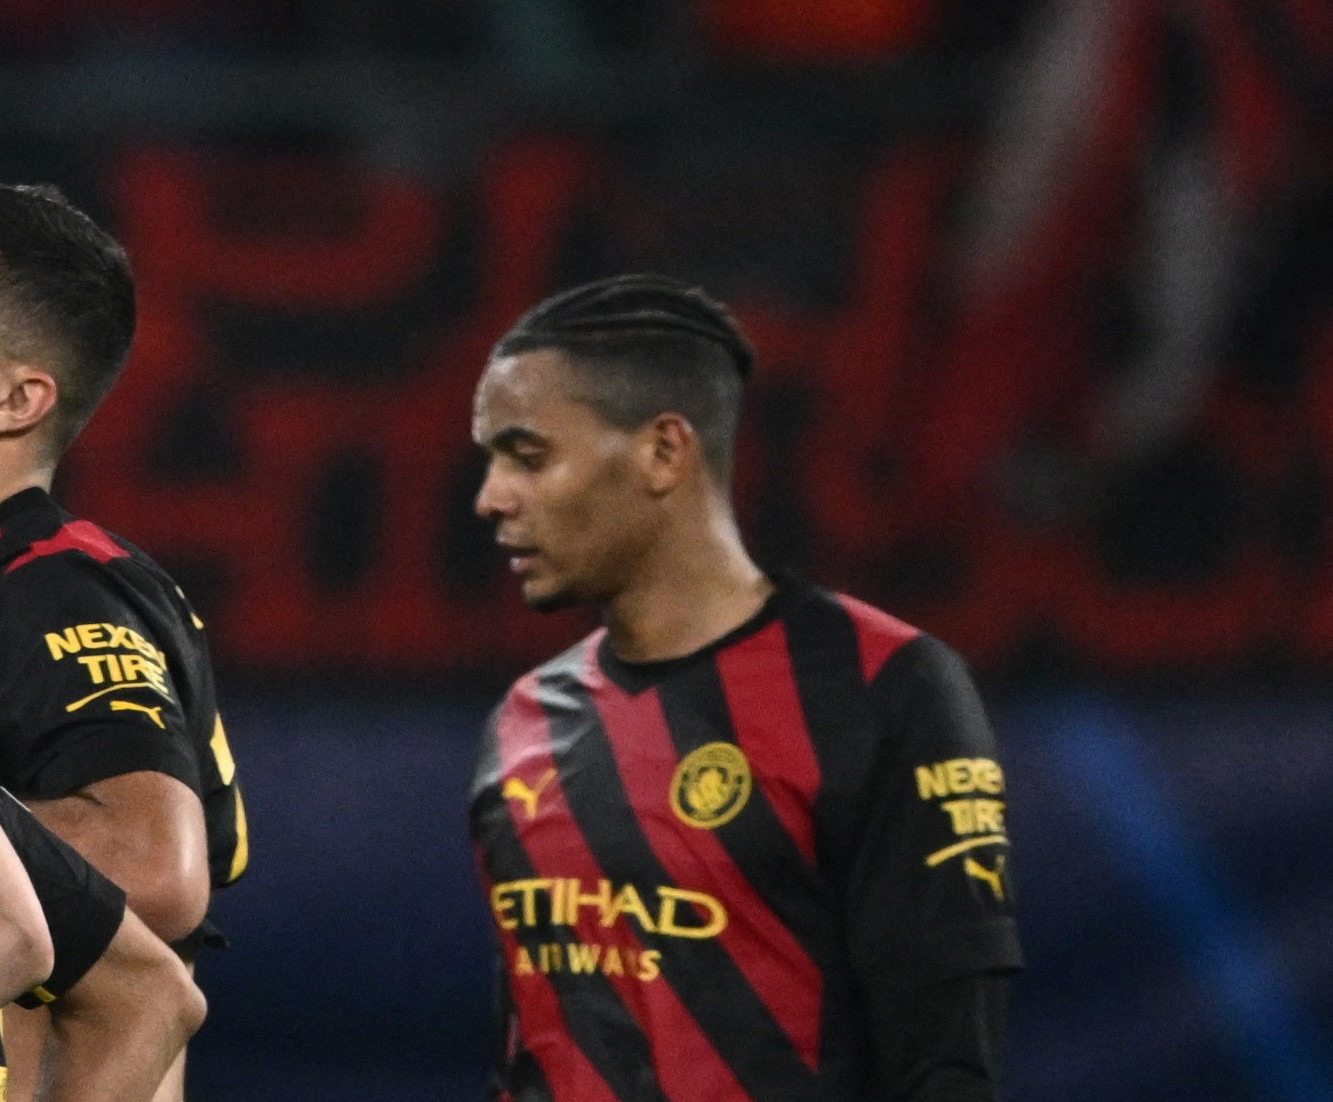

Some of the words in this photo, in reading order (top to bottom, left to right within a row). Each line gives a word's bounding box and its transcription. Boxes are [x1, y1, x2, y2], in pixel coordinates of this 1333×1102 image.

[77, 653, 170, 695] TIRE
[491, 877, 729, 940] ETIHAD
[514, 942, 662, 983] AIWAS
